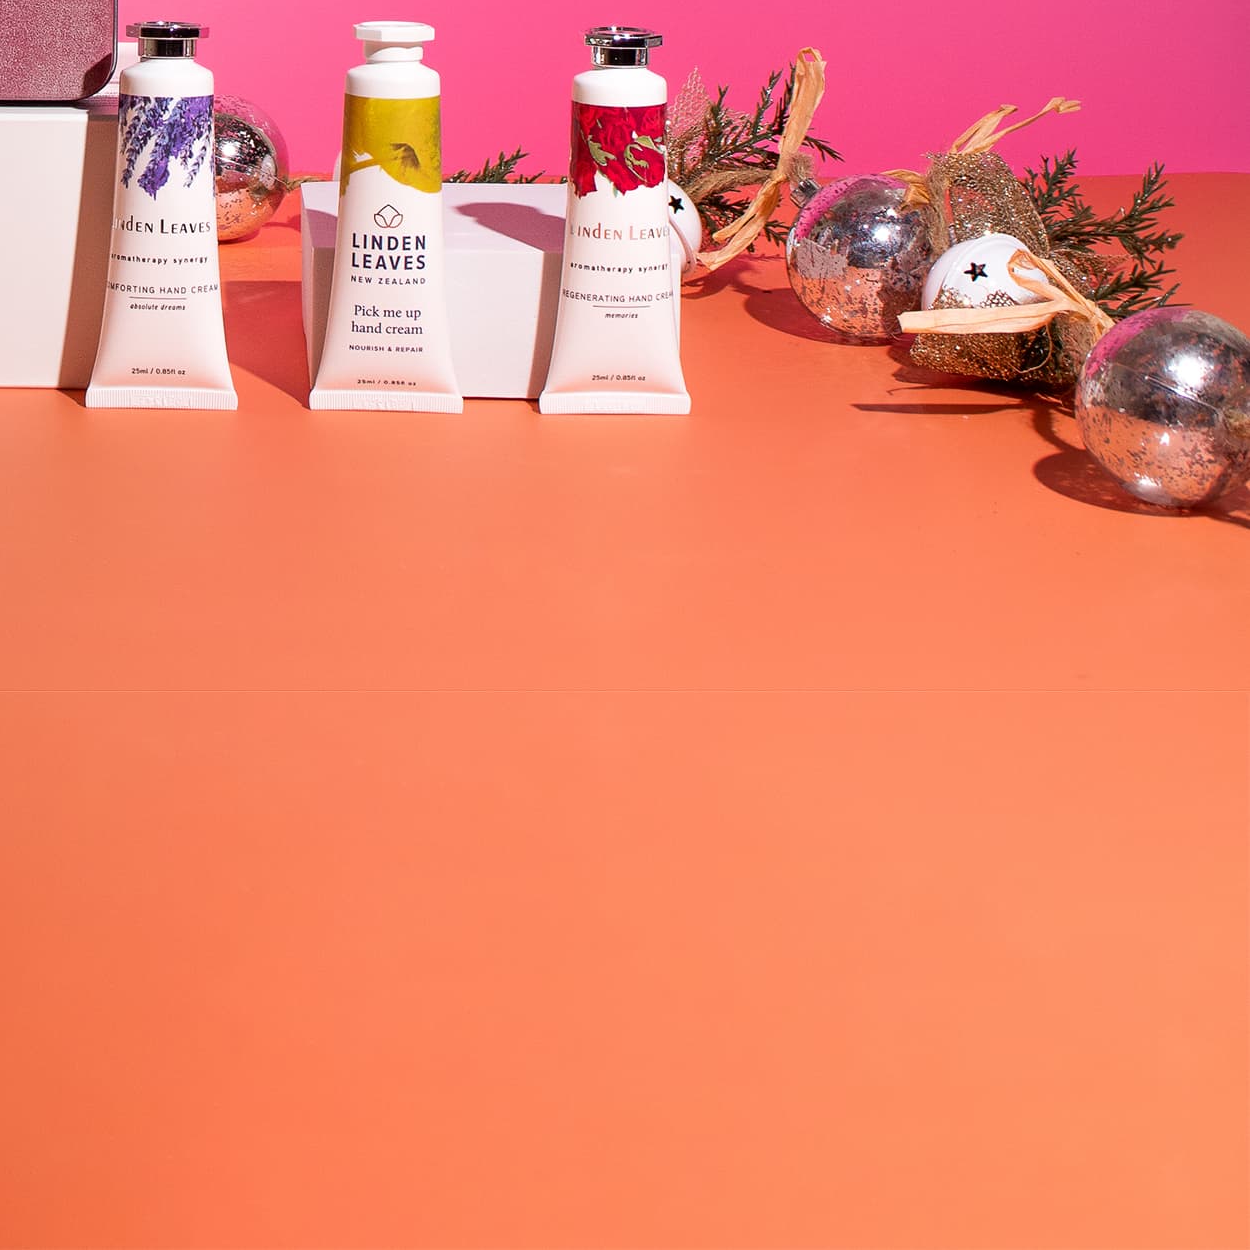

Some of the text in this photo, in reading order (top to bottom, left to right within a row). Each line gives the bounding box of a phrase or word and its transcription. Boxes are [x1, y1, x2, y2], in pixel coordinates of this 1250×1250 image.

[160, 218, 211, 235] LEAVES
[352, 233, 426, 251] LINDEN
[173, 255, 209, 266] synergy
[351, 252, 426, 270] LEAVES
[570, 261, 633, 274] aromatherapy
[350, 275, 426, 285] NEW ZEALAND
[159, 286, 187, 295] HAND
[629, 294, 653, 302] HAND
[129, 303, 186, 311] absolute dreams
[354, 305, 422, 321] Pick me up
[351, 321, 423, 335] hand cream
[349, 344, 385, 352] NOURISH
[131, 367, 149, 375] 25ml
